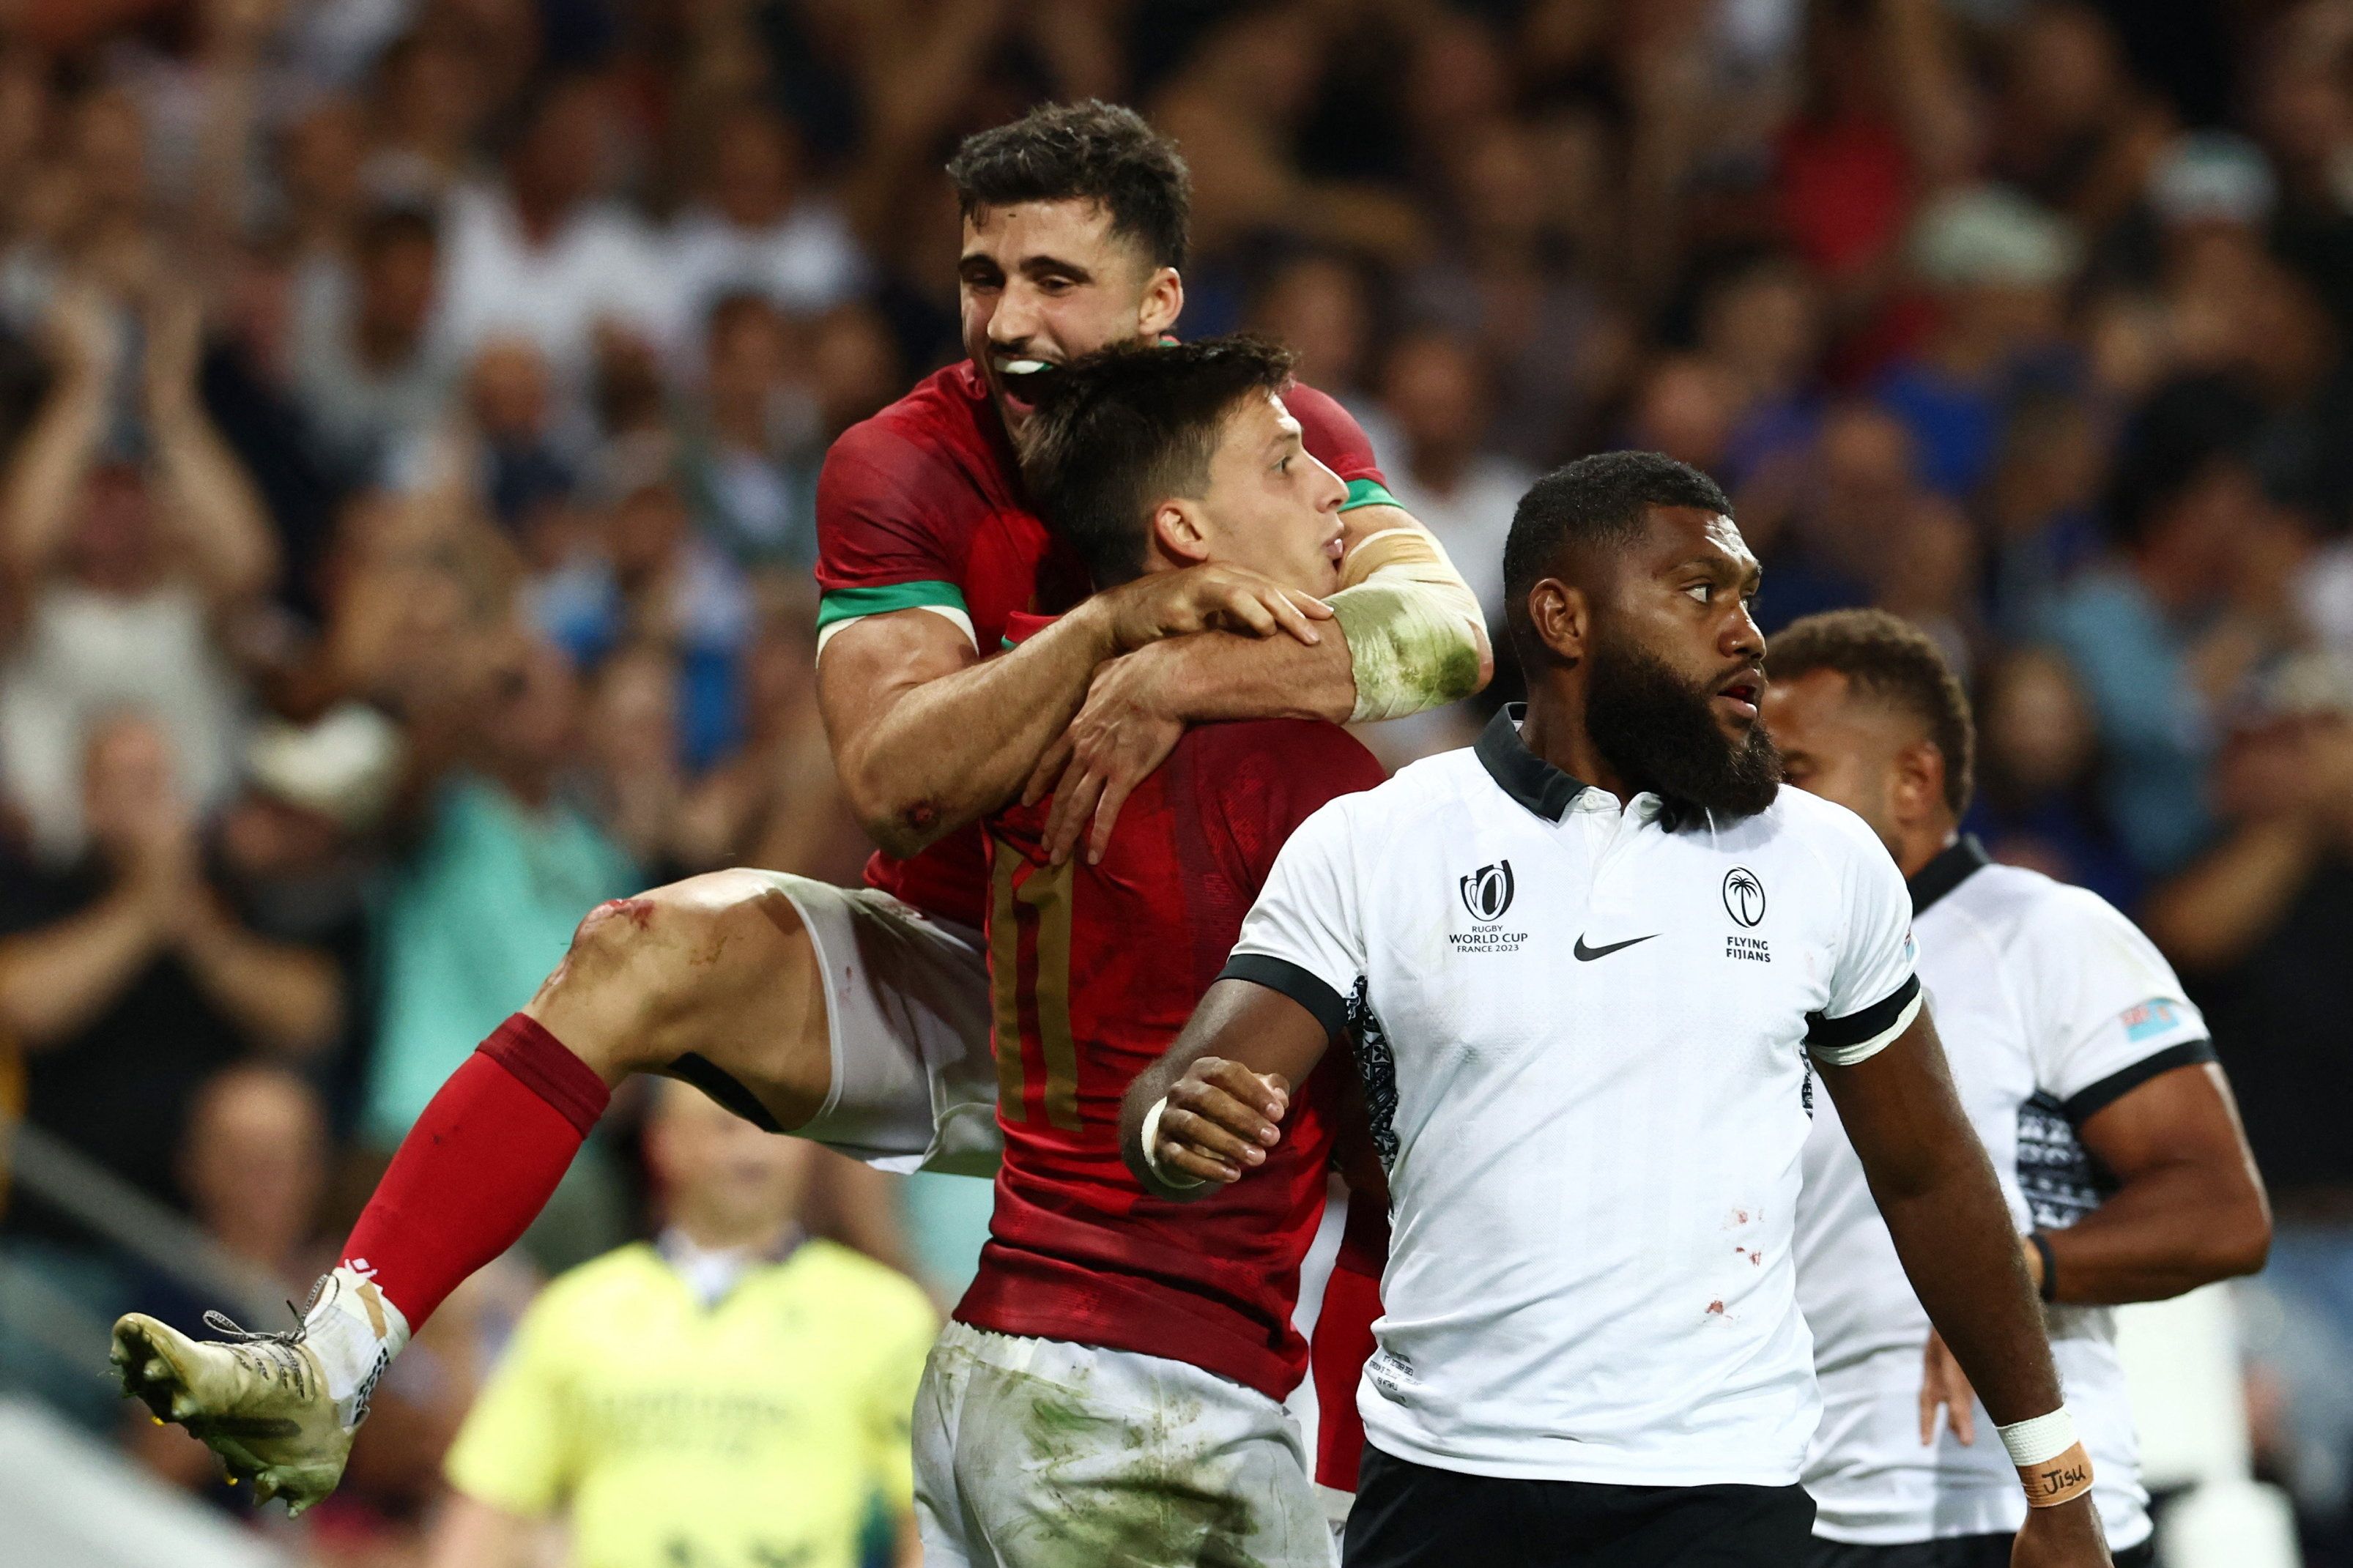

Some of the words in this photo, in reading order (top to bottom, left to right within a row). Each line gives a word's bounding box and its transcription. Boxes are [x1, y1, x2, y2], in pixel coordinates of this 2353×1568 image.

[1472, 925, 1503, 933] RUGBY
[1449, 934, 1499, 944] WORLD
[1502, 933, 1528, 943] CUP
[1727, 936, 1768, 951] FLYING
[1496, 944, 1519, 952] 2023
[1726, 948, 1771, 963] FIJIANS
[991, 837, 1083, 1132] 11
